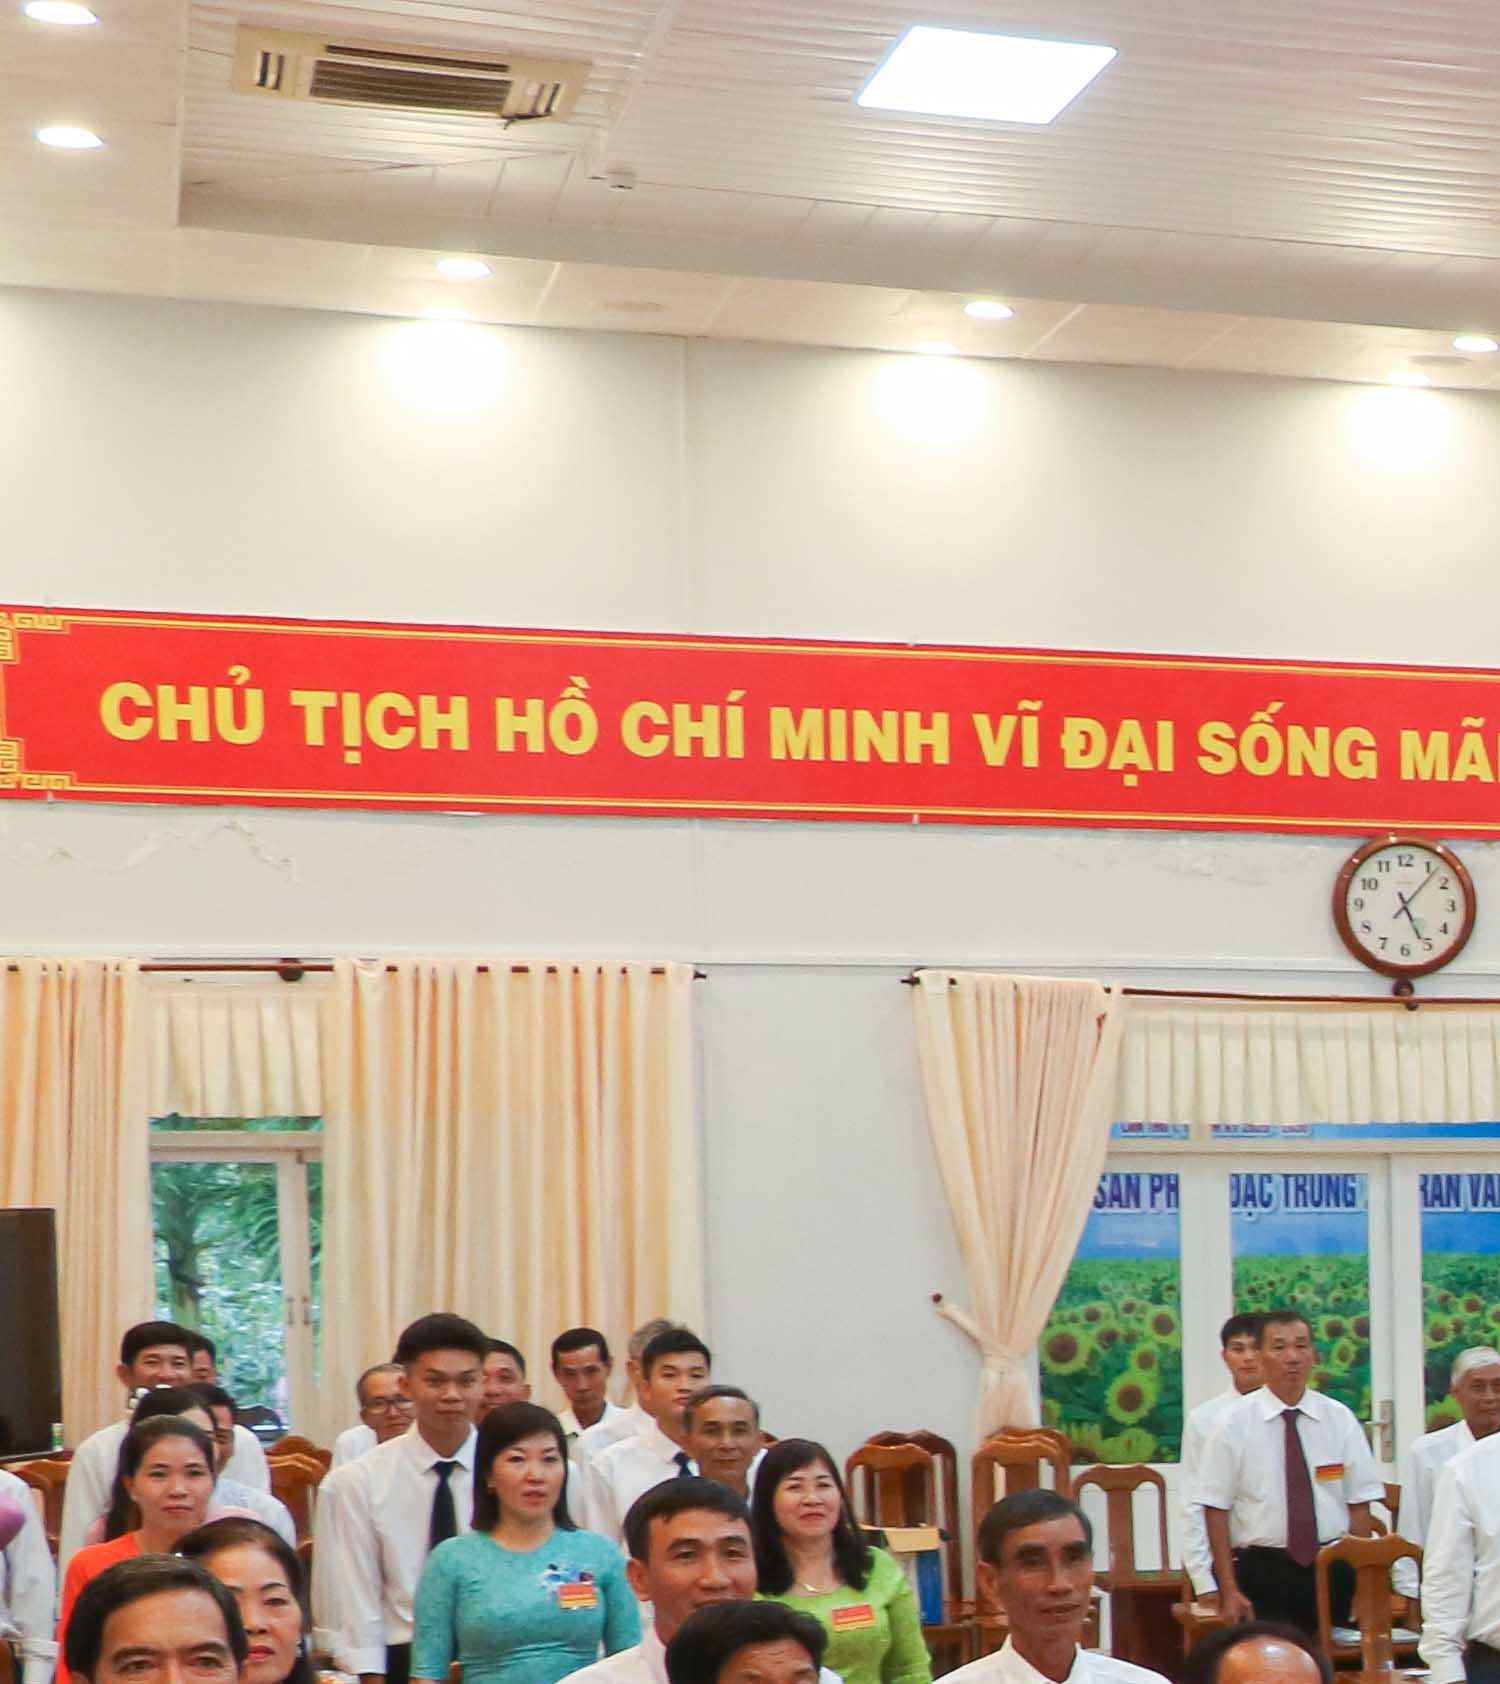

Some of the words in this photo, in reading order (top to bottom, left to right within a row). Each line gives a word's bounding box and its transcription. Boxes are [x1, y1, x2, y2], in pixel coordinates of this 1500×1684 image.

[100, 665, 265, 744] CHỦ
[290, 690, 469, 764] TỊCH
[495, 676, 598, 755] HỒ
[621, 690, 744, 758] CHÍ
[770, 707, 949, 764] MINH
[972, 700, 1042, 767] VĨ
[1060, 717, 1173, 786] ĐẠI
[1198, 702, 1377, 779] SỐNG
[1377, 861, 1390, 872] 11
[1397, 855, 1414, 867] 12
[1361, 878, 1378, 890] 10
